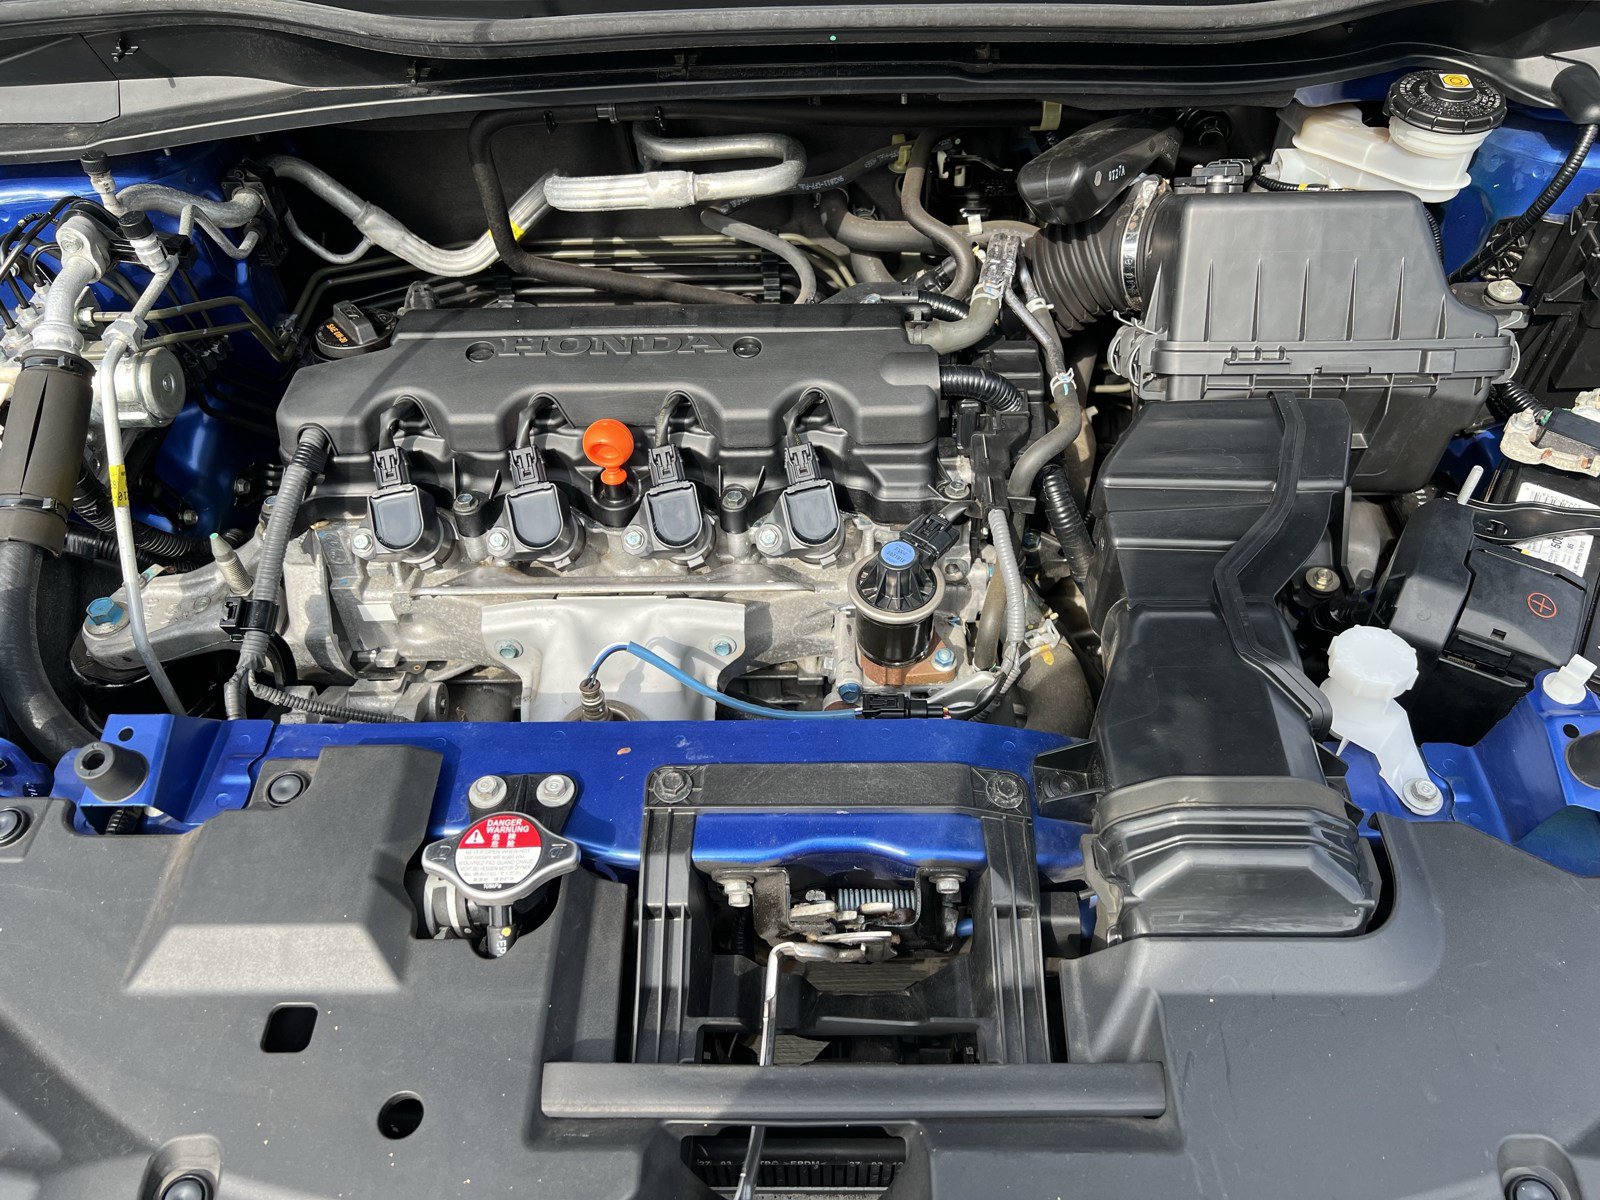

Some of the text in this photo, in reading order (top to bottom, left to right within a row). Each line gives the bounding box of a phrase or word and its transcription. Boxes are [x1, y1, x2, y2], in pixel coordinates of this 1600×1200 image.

[498, 335, 728, 356] HONDA
[486, 818, 523, 827] DANGER
[486, 825, 530, 834] WARNUNG
